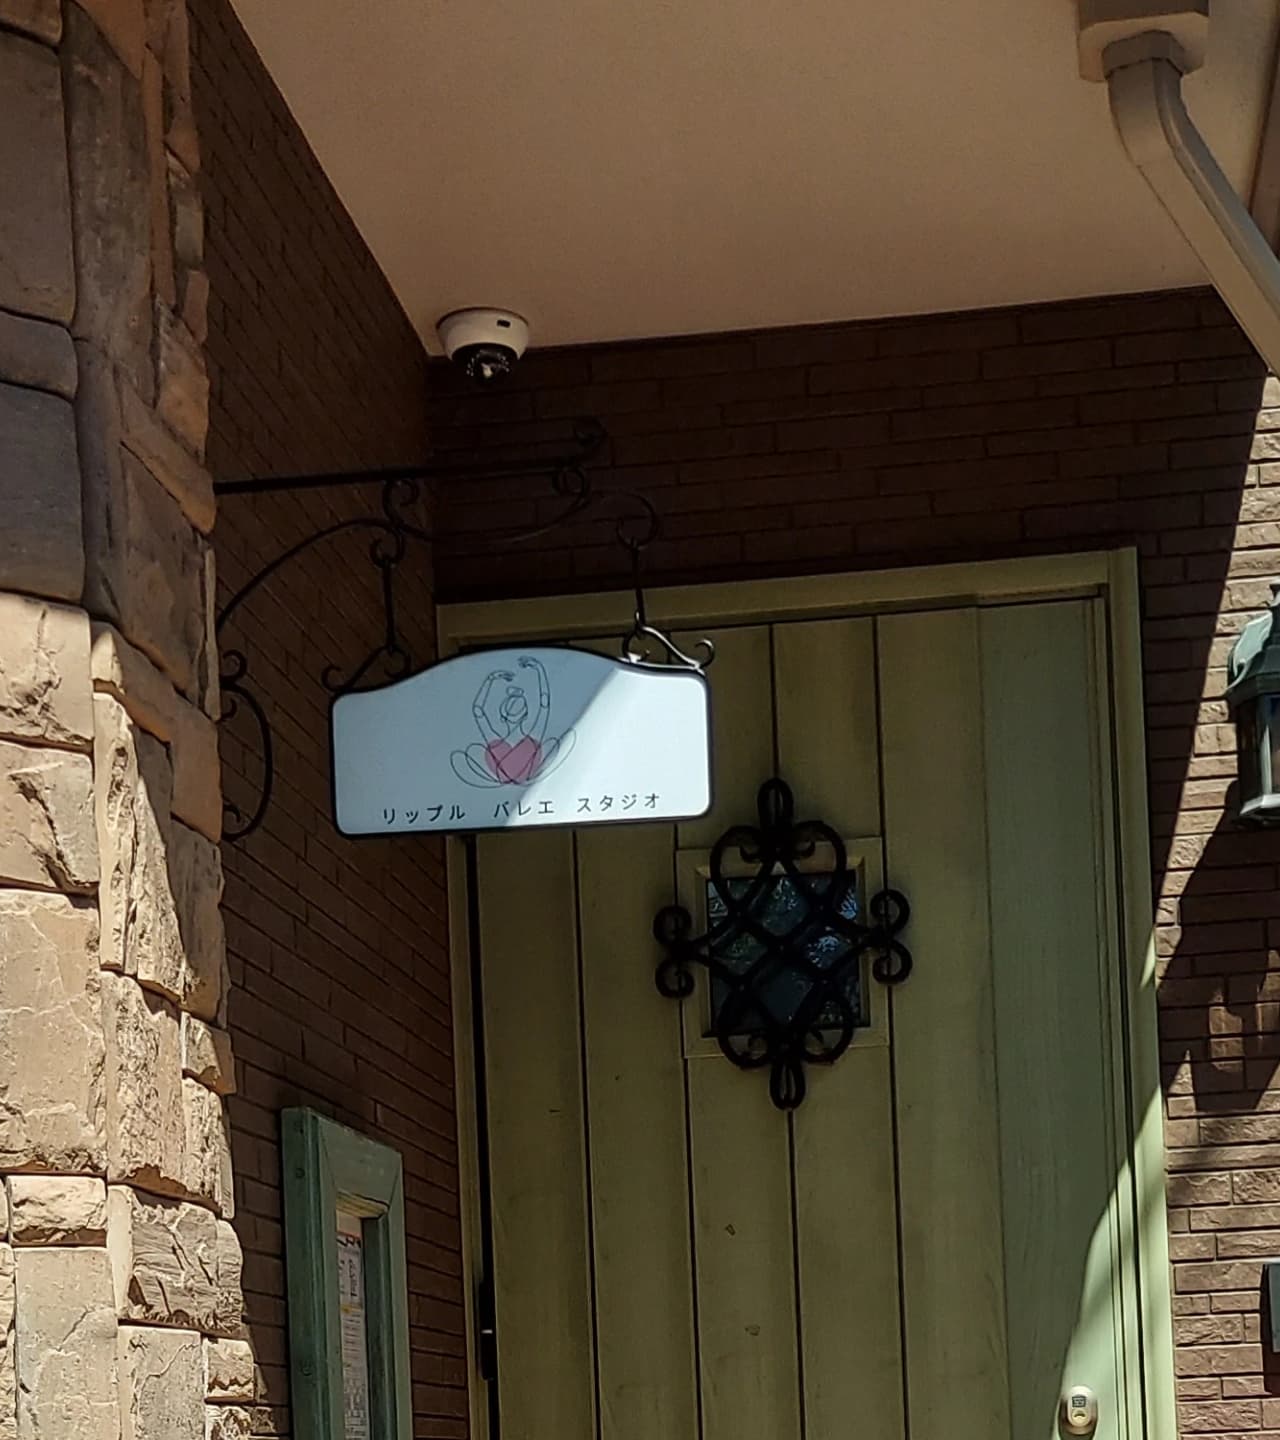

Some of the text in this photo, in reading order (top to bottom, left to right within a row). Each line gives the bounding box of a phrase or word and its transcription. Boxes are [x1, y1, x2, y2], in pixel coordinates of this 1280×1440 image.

[382, 792, 660, 825] リップル バレエ スタジオ
